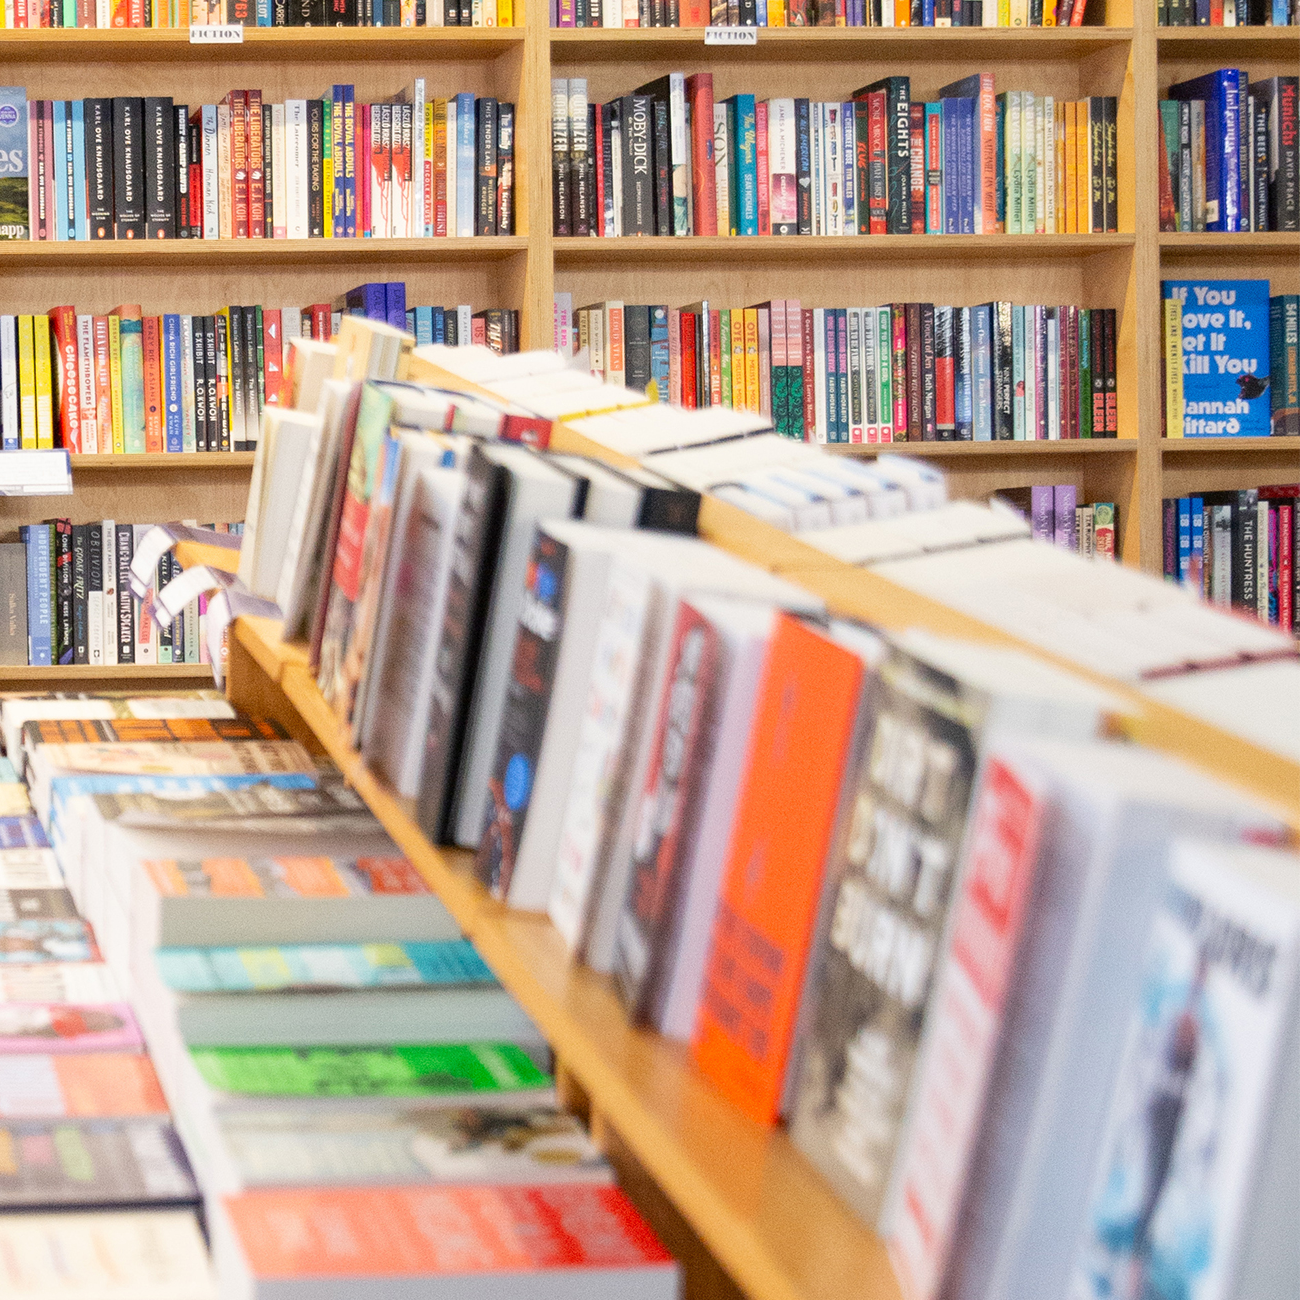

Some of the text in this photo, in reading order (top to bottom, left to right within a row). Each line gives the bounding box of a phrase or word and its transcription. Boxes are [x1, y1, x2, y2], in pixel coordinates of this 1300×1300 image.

[191, 30, 241, 39] FICTION
[706, 32, 755, 40] FICTION
[155, 107, 163, 126] KARL
[1282, 86, 1297, 145] Munichs
[633, 100, 646, 174] MOBY-DICK
[897, 103, 909, 156] EIGHTS
[1286, 181, 1294, 210] PEACE
[1193, 287, 1236, 306] You
[1229, 310, 1252, 330] It,
[1210, 332, 1226, 351] It
[1215, 355, 1257, 374] You
[1106, 392, 1116, 430] EILEEN
[1244, 521, 1253, 599] THE HUNTRESS
[39, 530, 49, 623] INDEPENDENT PEOPLE
